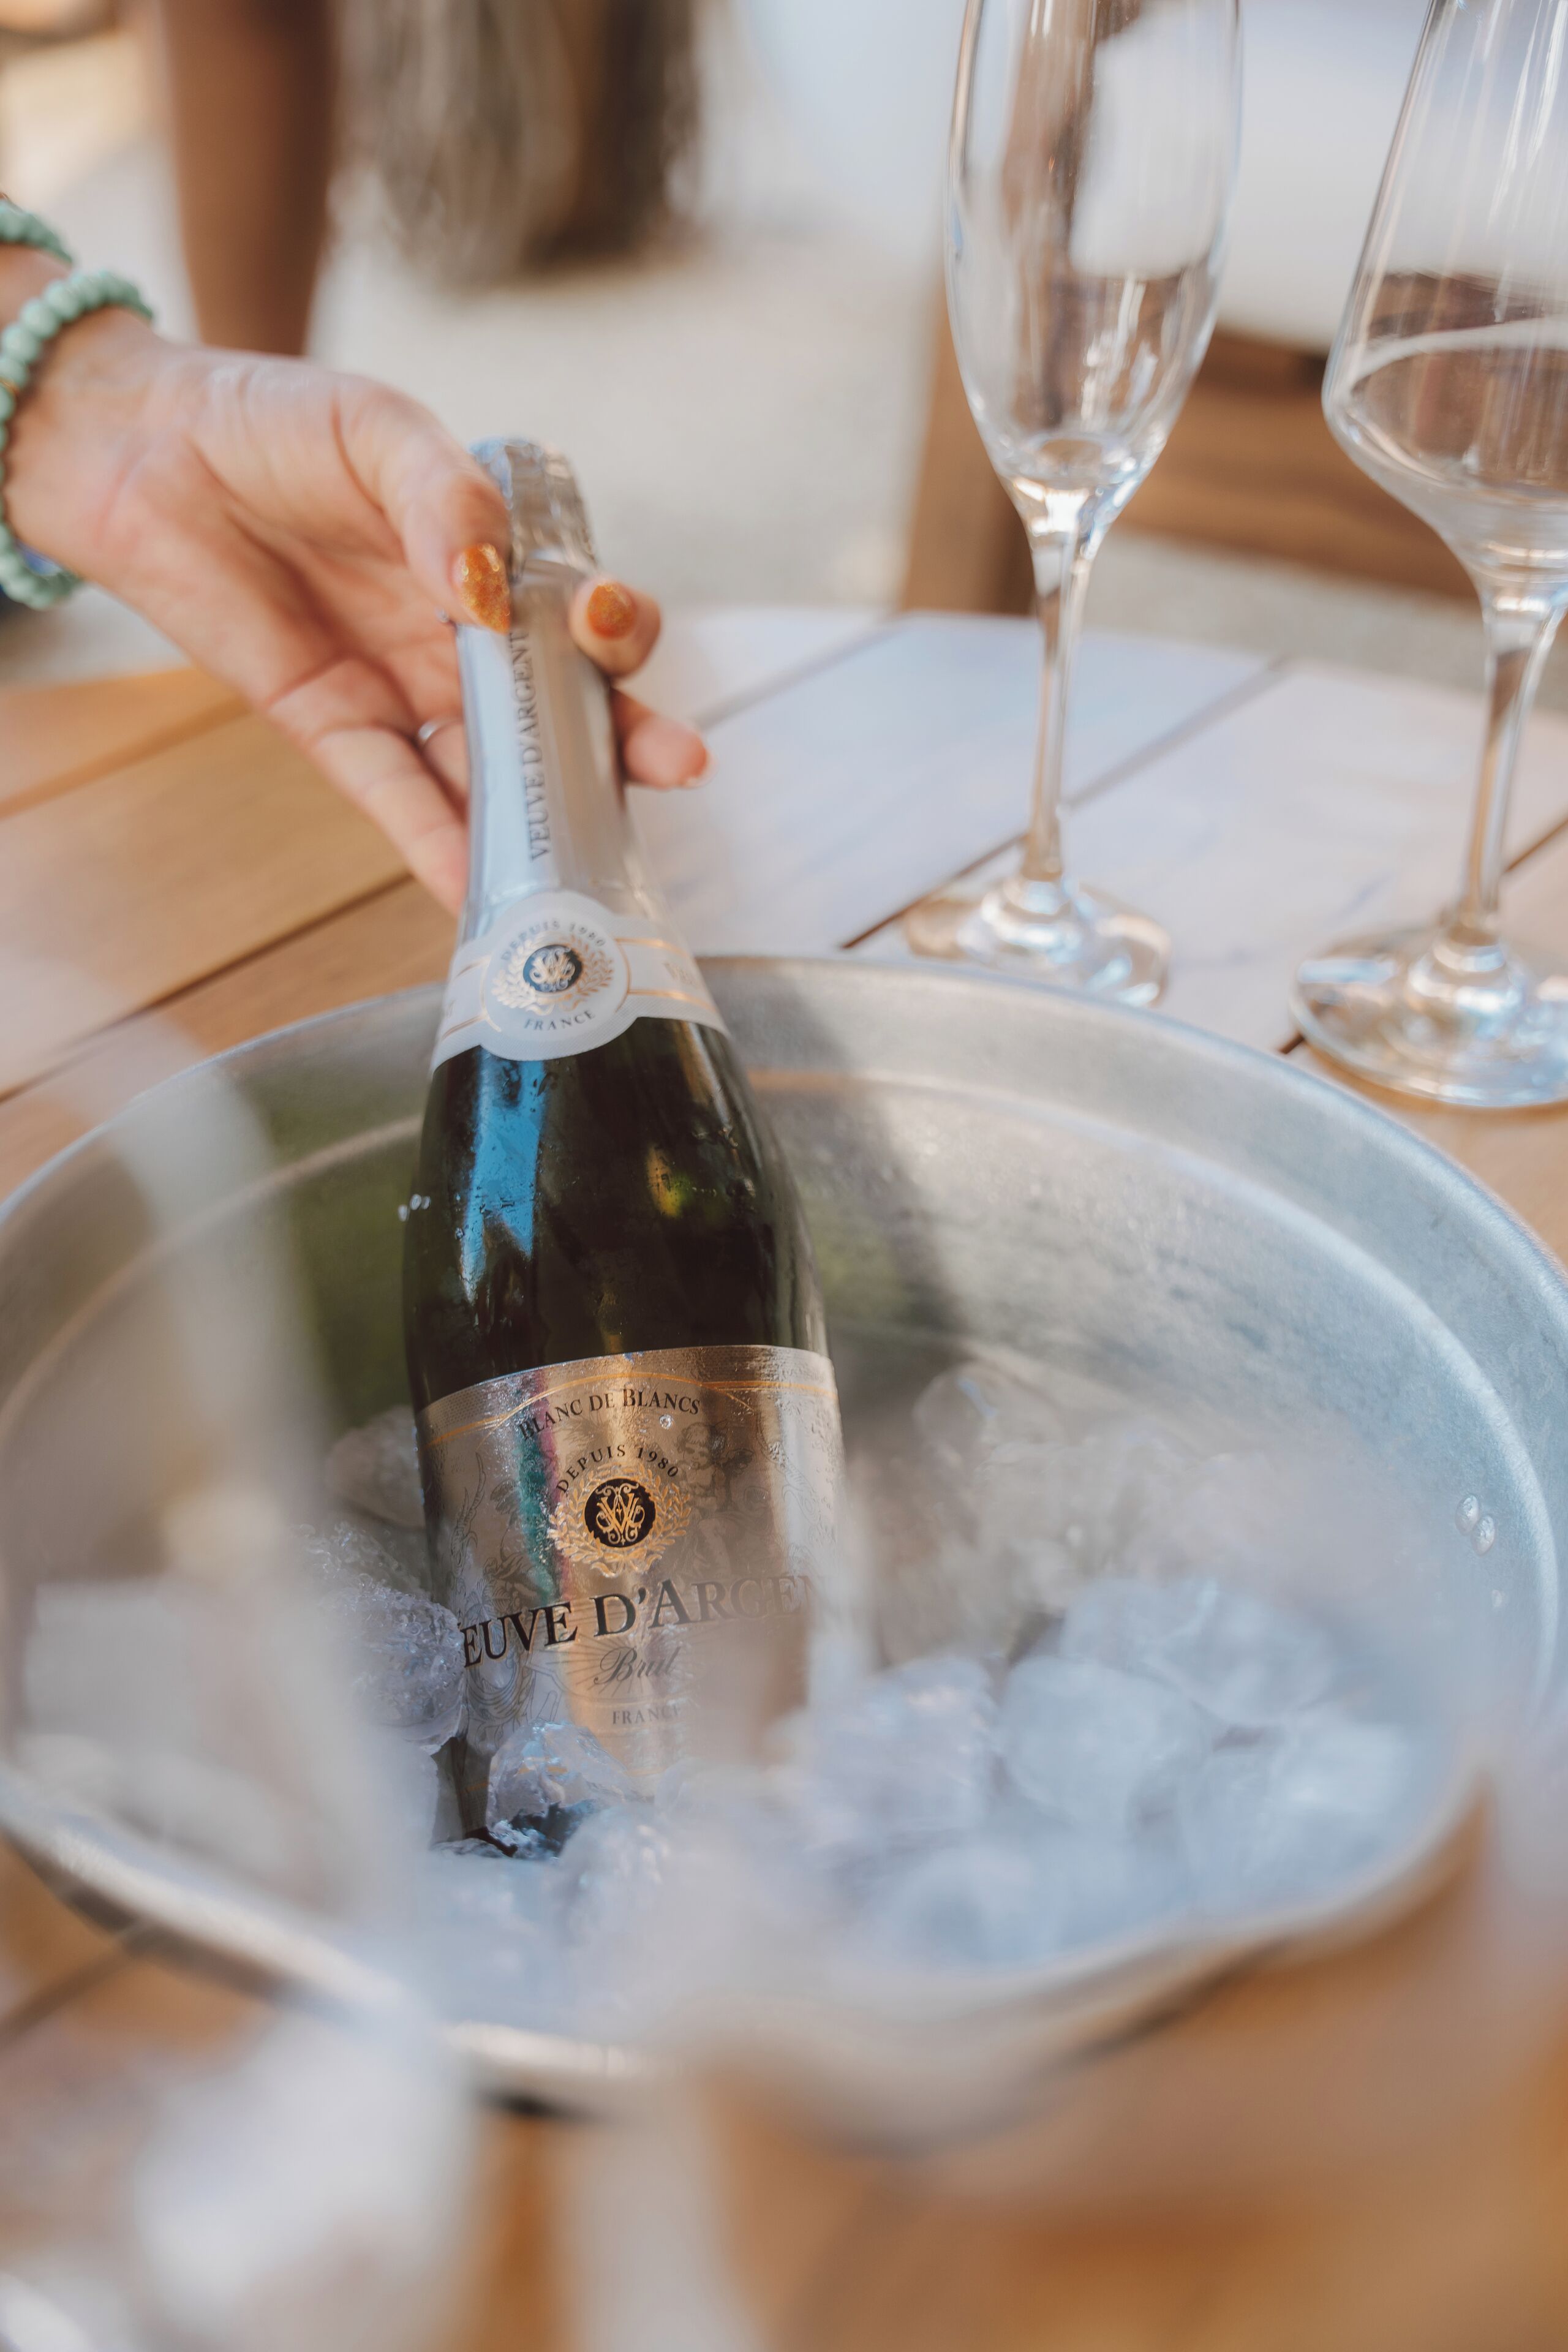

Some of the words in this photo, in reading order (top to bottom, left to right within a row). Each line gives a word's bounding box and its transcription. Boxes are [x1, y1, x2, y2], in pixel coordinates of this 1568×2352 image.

[523, 774, 551, 862] VEUVE
[501, 919, 560, 960] DEPUIS
[524, 1009, 595, 1030] FRANCE
[519, 1400, 583, 1440] BLANC
[589, 1393, 614, 1411] DE
[622, 1389, 701, 1414] BLANCS
[556, 1444, 625, 1494] DEPUIS
[638, 1446, 680, 1478] 1980
[458, 1604, 578, 1668] EUVE
